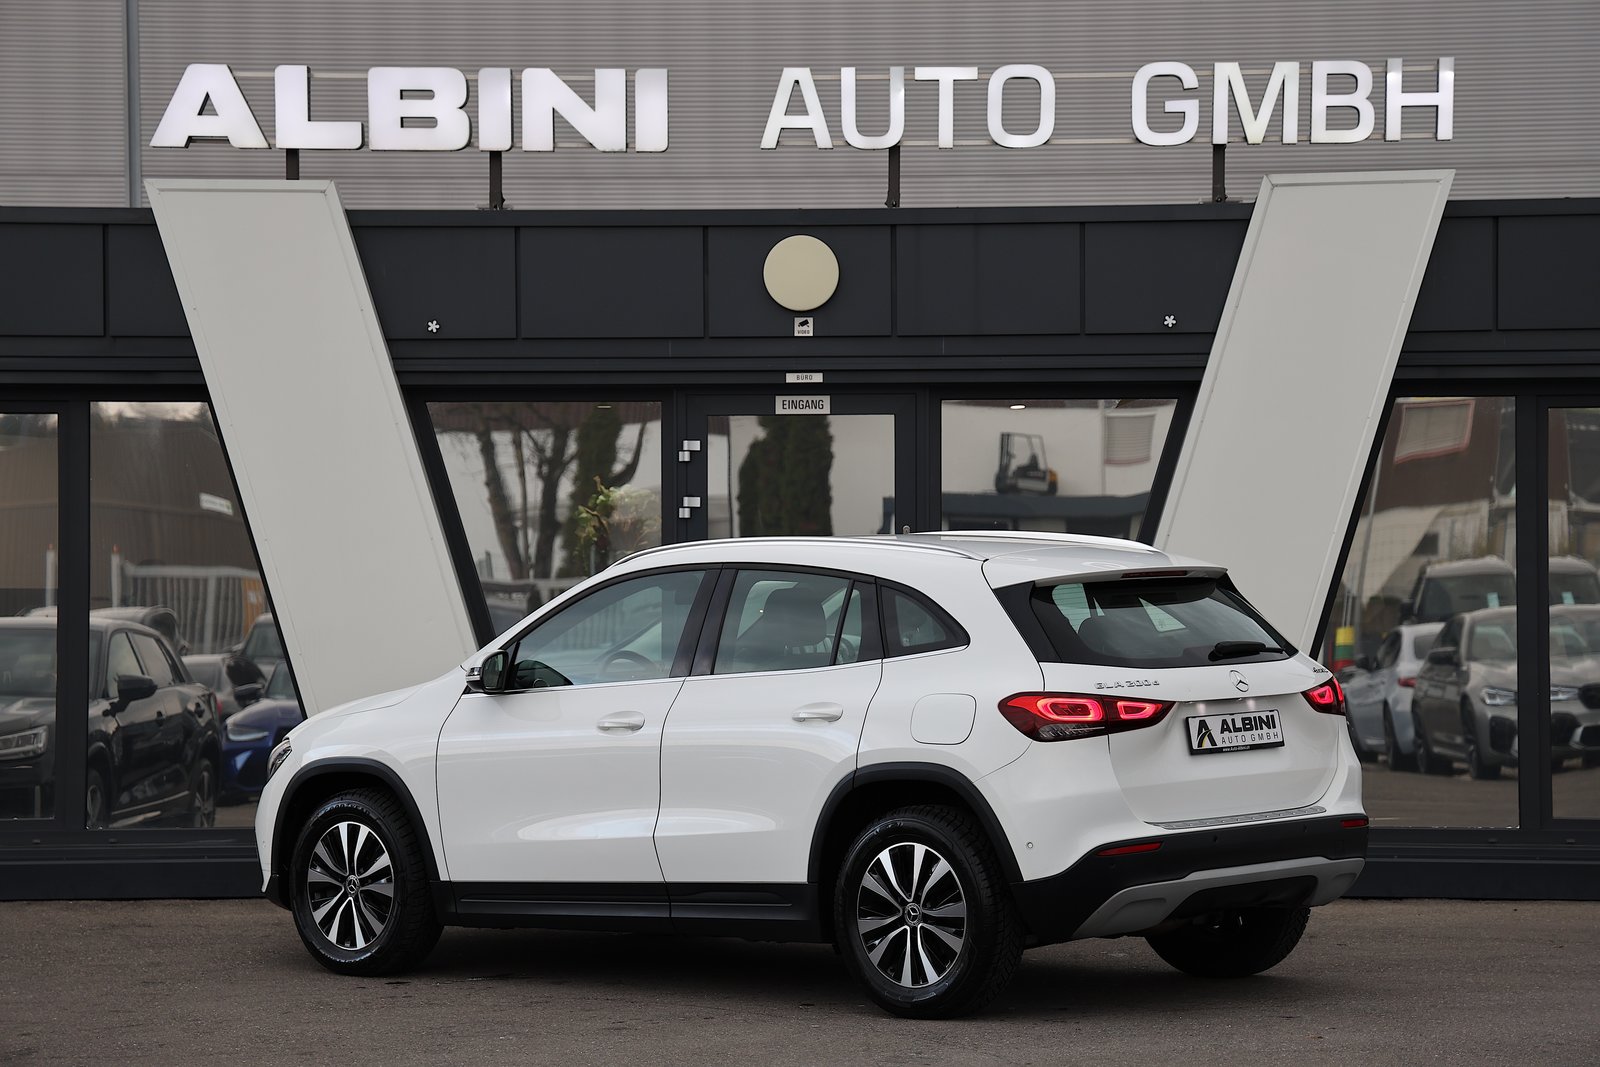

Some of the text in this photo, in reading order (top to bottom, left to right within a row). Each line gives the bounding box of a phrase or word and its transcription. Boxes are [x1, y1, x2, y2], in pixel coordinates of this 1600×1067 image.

[149, 57, 1455, 152] ALBINI AUTO GMBH
[782, 399, 824, 410] EINGANG
[1220, 714, 1277, 735] ALBINI
[1221, 731, 1279, 745] AUTO GMBH
